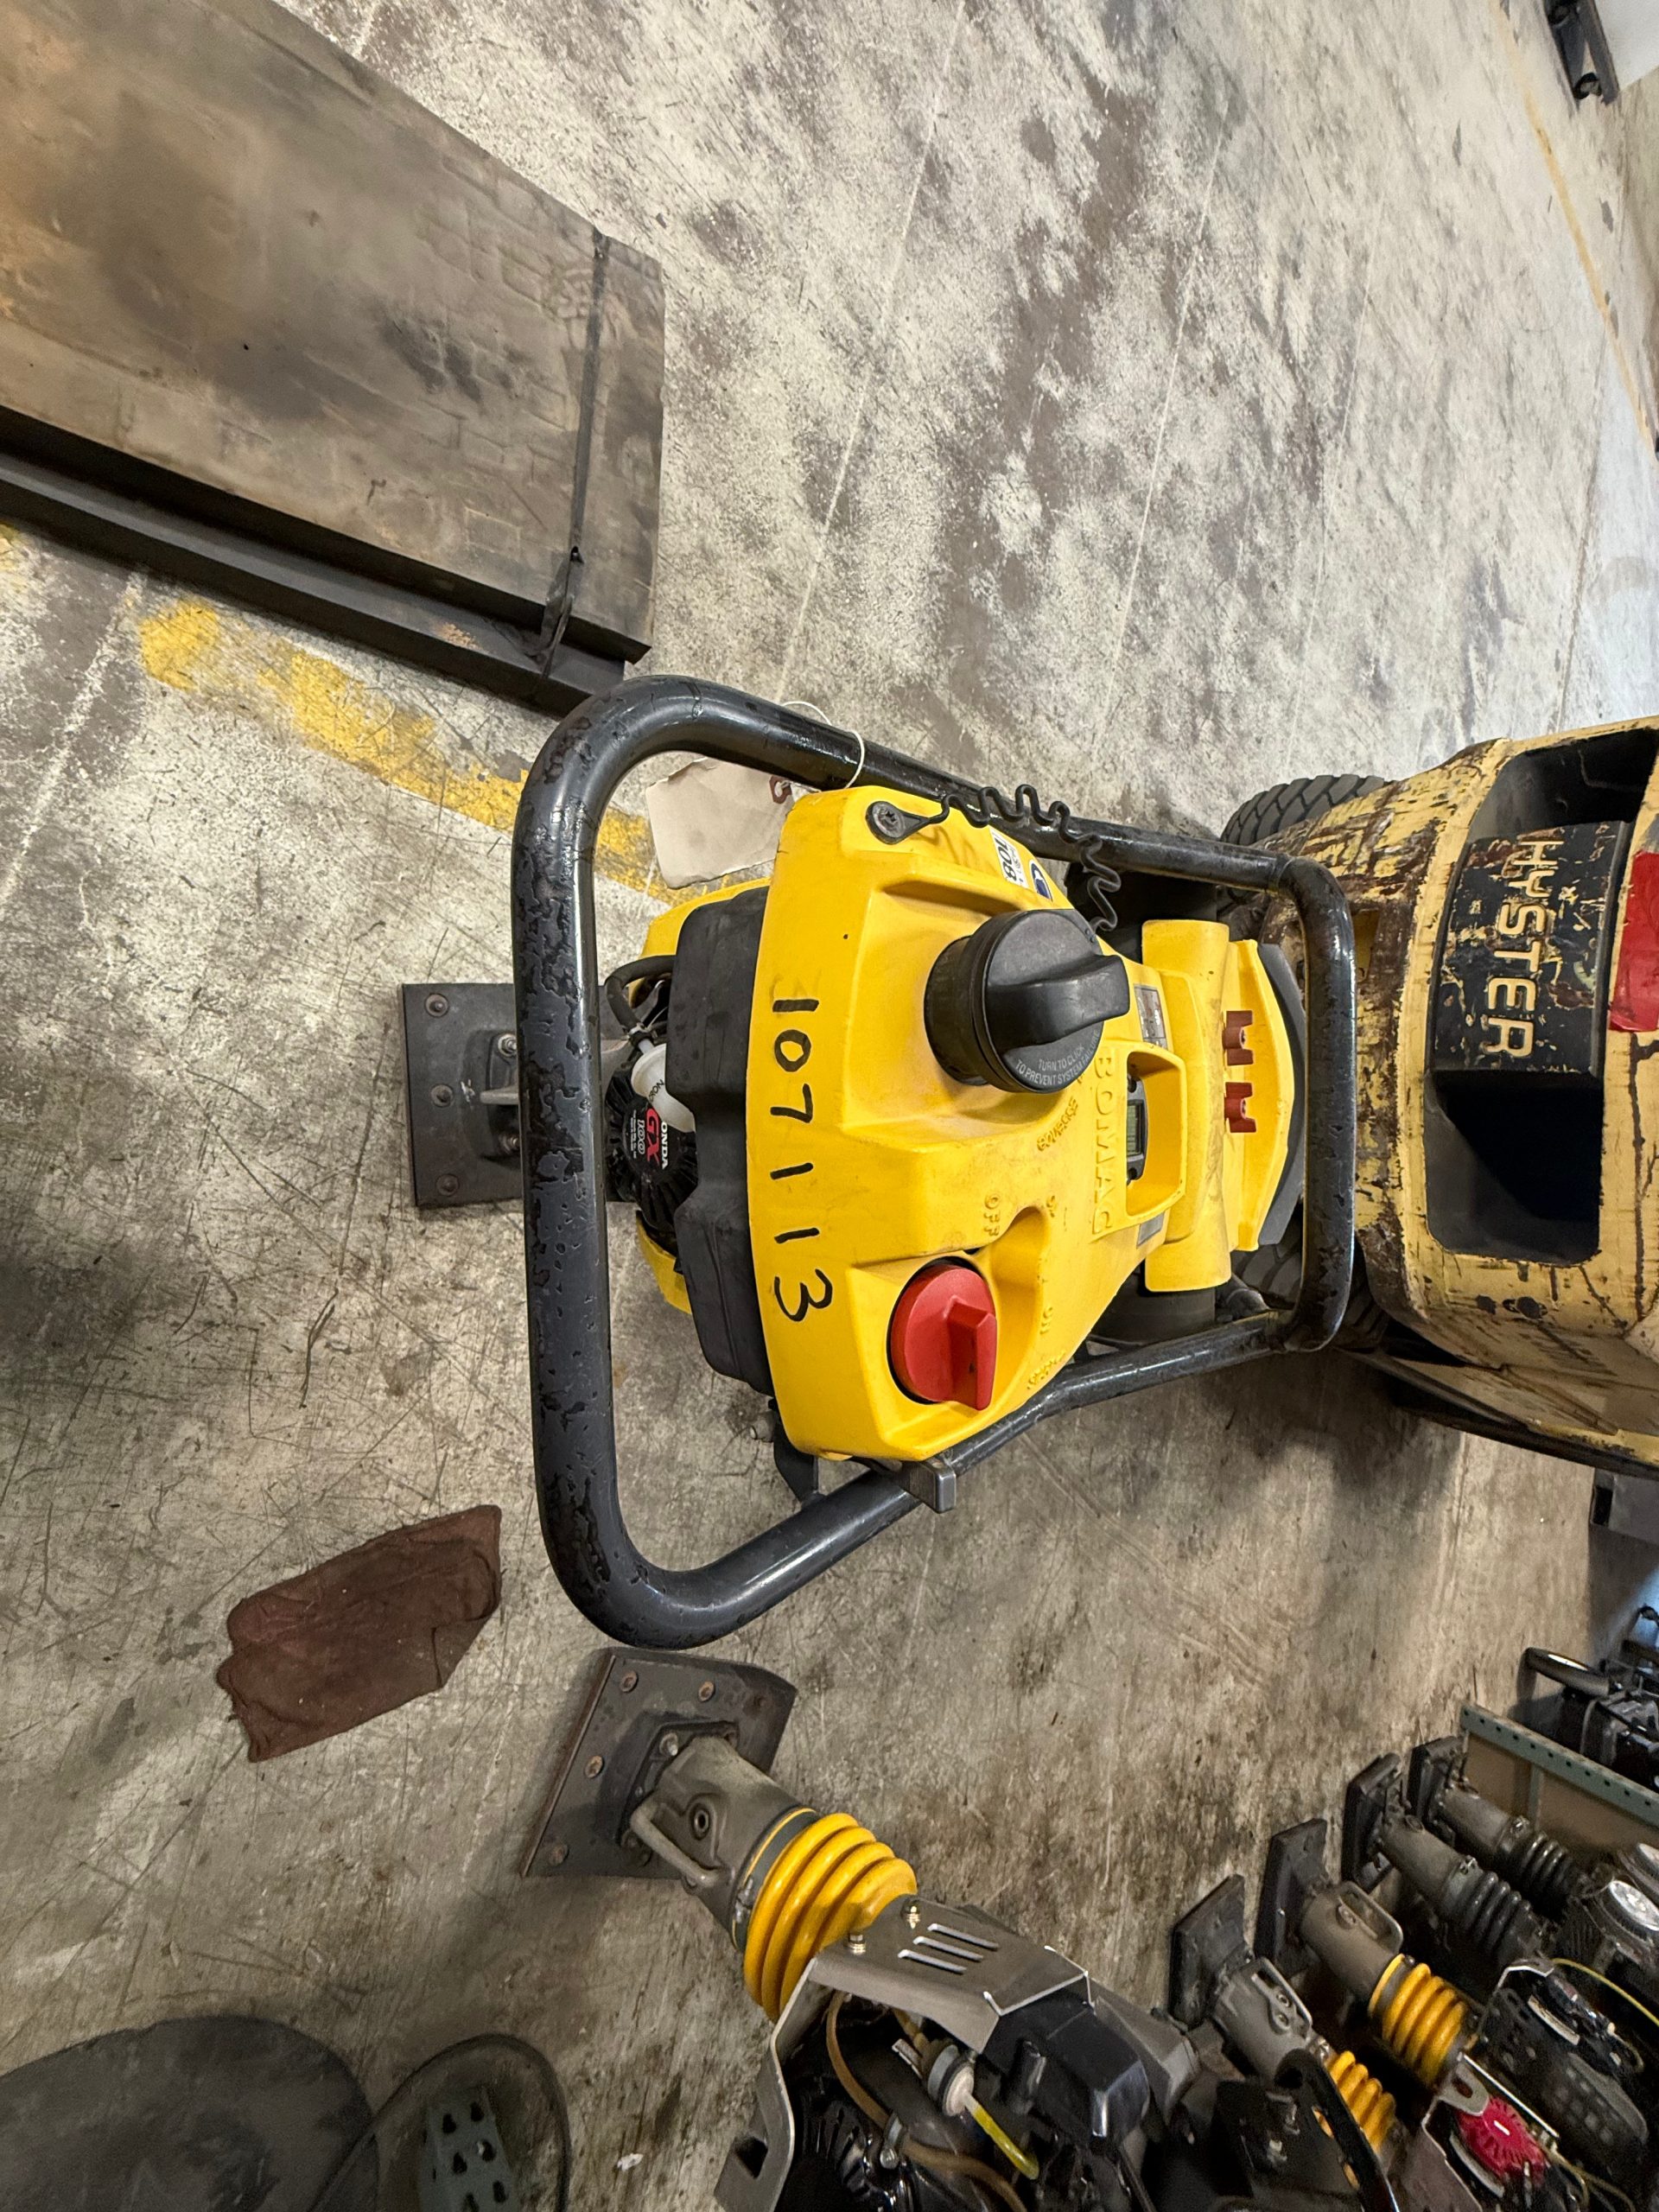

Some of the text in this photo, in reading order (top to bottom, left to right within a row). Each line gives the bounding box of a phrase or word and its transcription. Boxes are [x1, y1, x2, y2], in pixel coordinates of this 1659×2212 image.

[1487, 840, 1565, 1058] HYSTER
[1015, 1059, 1026, 1075] TO
[1025, 1066, 1057, 1086] PREVENT
[1057, 1060, 1084, 1084] SYSTEM
[1039, 1044, 1085, 1071] TURN TO CLICK
[646, 1109, 659, 1166] GX
[1093, 1052, 1116, 1236] BOMAG
[983, 1195, 1001, 1236] OFF
